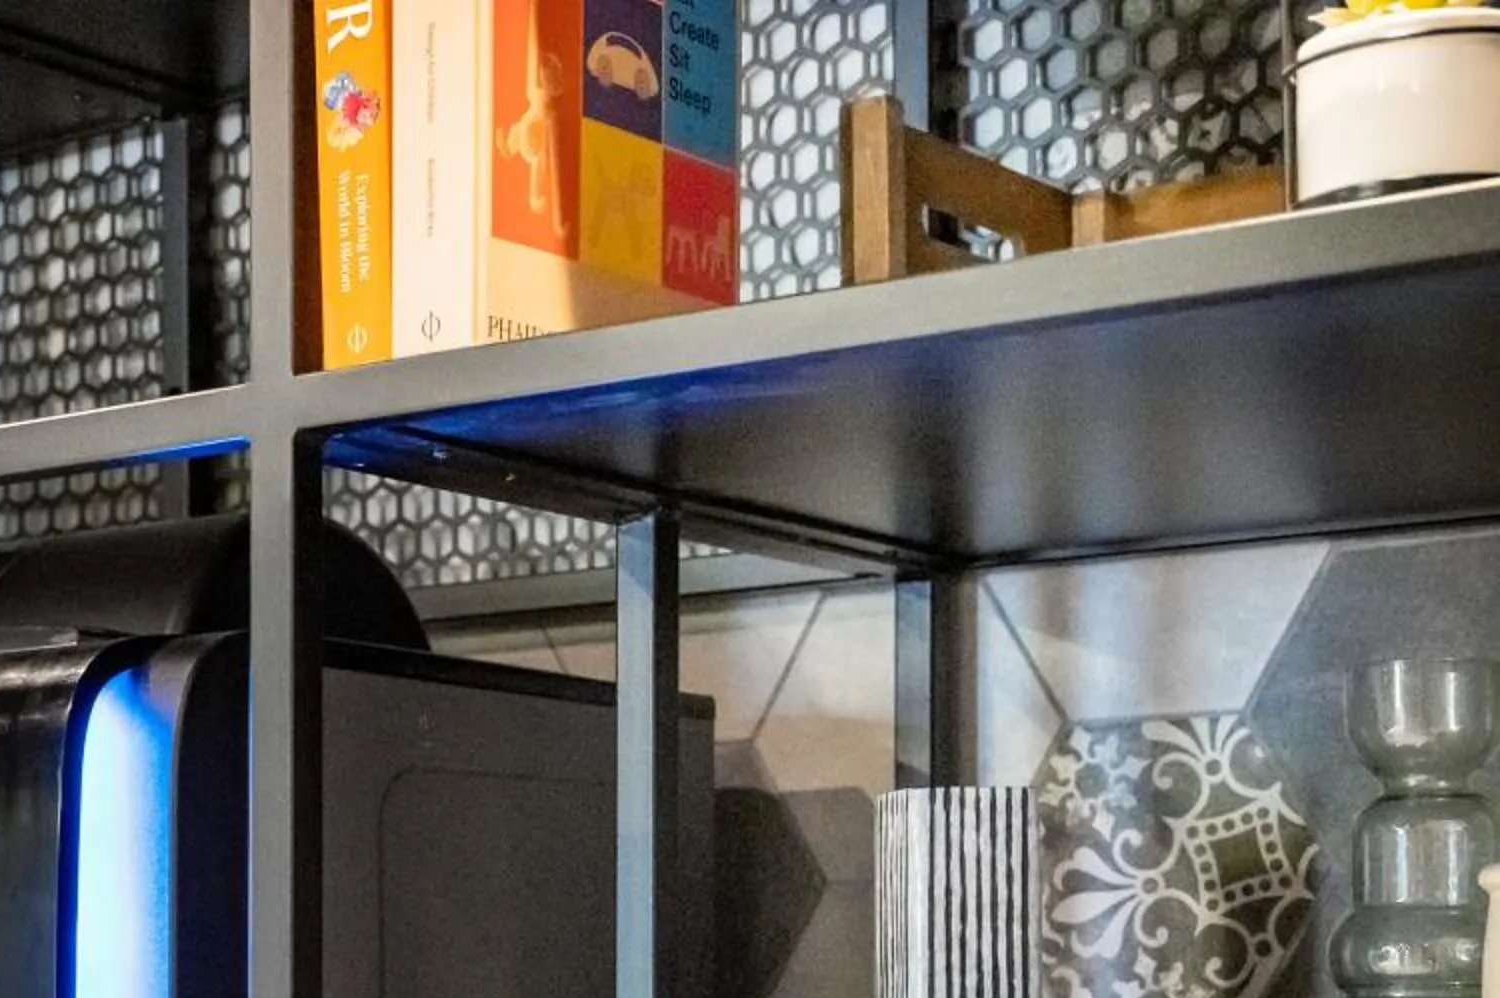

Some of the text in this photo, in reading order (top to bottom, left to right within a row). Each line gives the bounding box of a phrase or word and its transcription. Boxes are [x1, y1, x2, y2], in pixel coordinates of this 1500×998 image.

[668, 10, 720, 52] Create
[668, 43, 690, 73] Sit
[668, 76, 712, 117] Sleep
[338, 169, 352, 218] World
